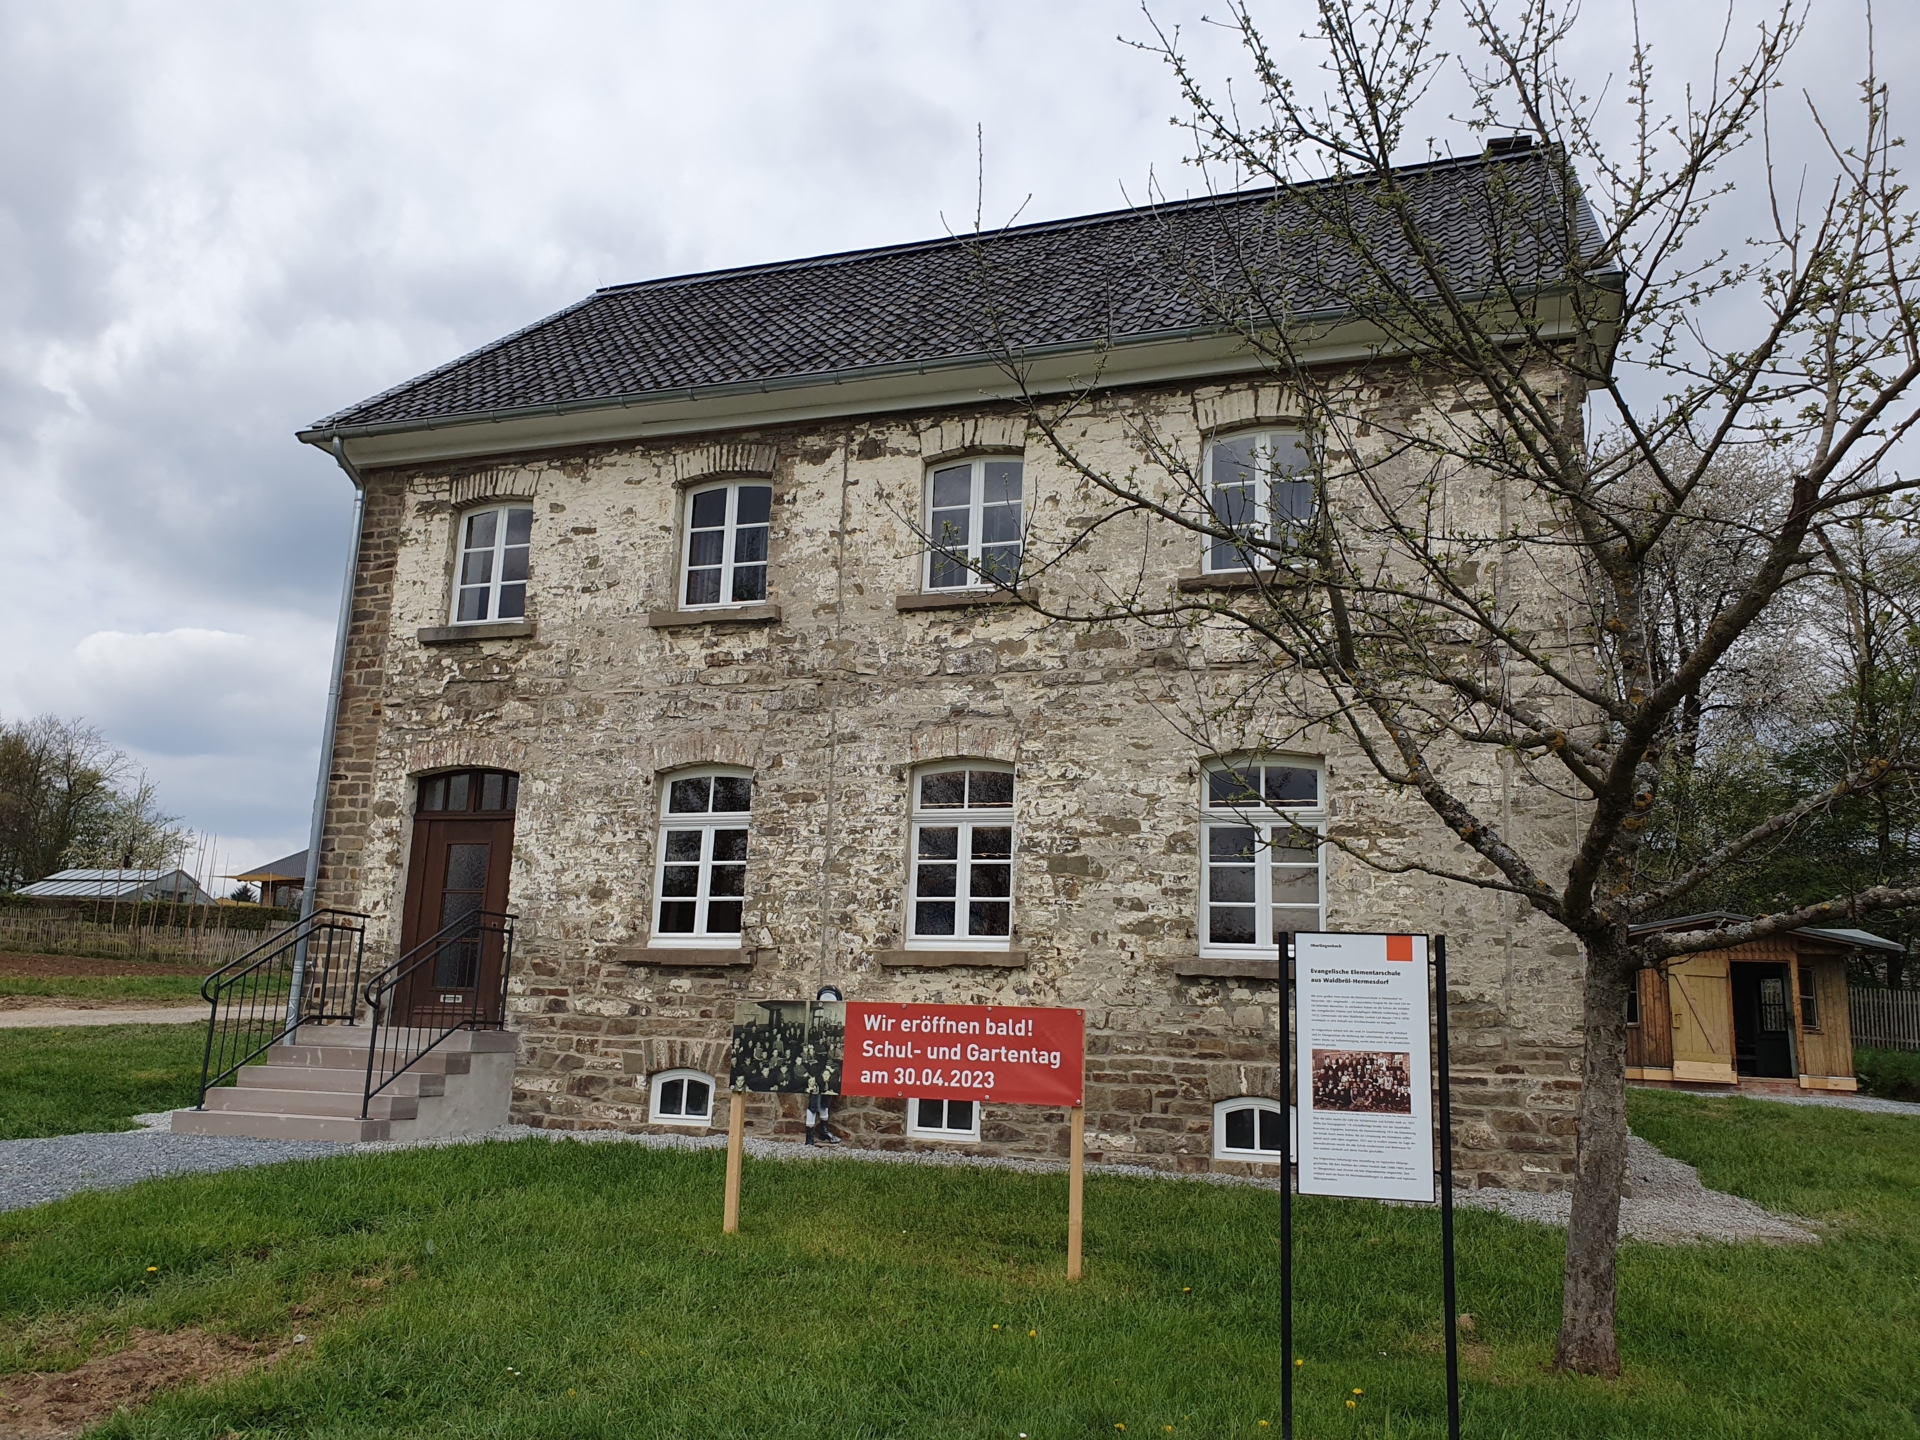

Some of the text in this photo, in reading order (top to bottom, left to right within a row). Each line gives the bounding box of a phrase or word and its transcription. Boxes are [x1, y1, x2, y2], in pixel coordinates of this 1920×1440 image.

[1310, 968, 1349, 976] Evangelische
[864, 1014, 1033, 1037] Wir eröffnen bald!
[862, 1040, 1061, 1068] Schul- und Gartentag
[860, 1068, 995, 1089] am 30.04.2023
